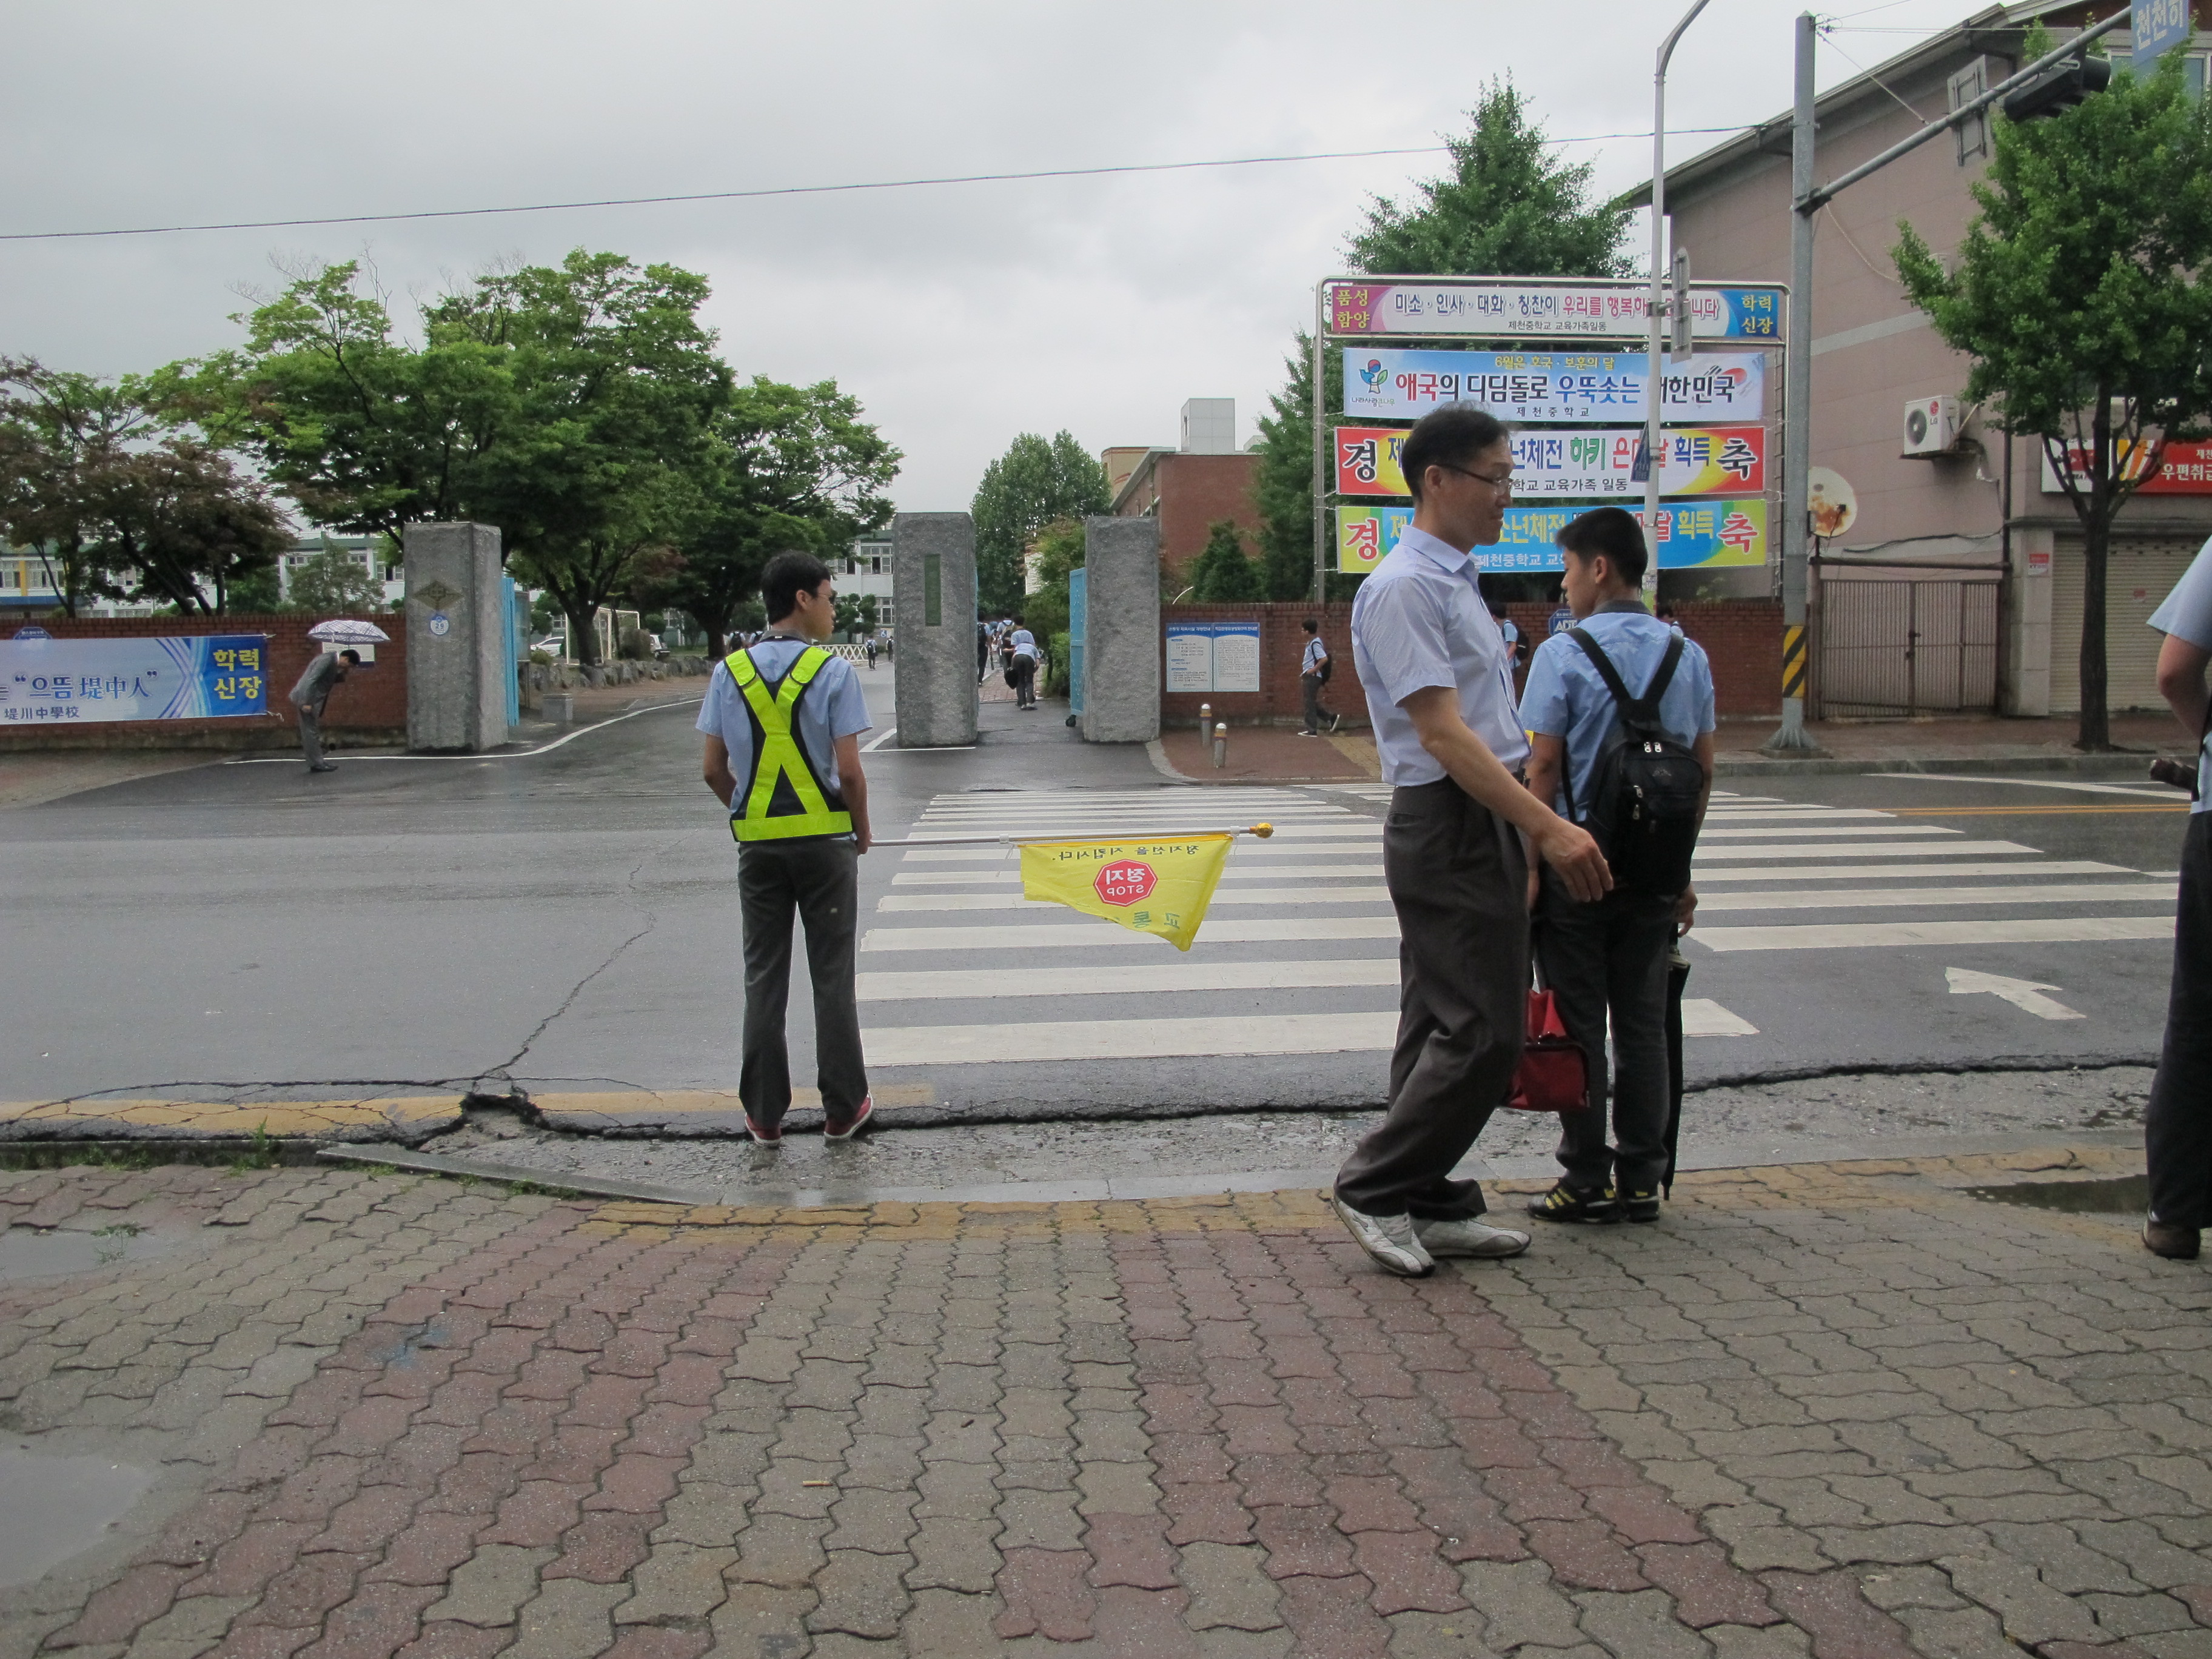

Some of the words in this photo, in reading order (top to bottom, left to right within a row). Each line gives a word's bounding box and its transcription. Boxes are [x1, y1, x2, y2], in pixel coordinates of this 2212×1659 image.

[1336, 289, 1368, 306] 품성
[1518, 294, 1558, 315] 칭찬이
[1563, 295, 1601, 316] 우리를
[1607, 296, 1649, 317] 행복하
[1741, 295, 1772, 312] 학력
[1336, 311, 1369, 328] 함양
[1508, 320, 1551, 330] 제천중학교
[1555, 321, 1607, 332] 교육가족일동
[1741, 316, 1773, 334] 신장
[1495, 356, 1524, 370] 6월은
[1531, 356, 1552, 369] 호국
[1564, 357, 1598, 370] 보훈의
[1603, 356, 1615, 370] 달
[1396, 374, 1459, 401] 애국의
[1467, 375, 1549, 403] 디딤돌로
[1555, 376, 1641, 403] 우뚝솟는
[1516, 406, 1589, 417] 제천중학교
[1342, 440, 1376, 482] 경
[1570, 437, 1606, 470] 하키
[1674, 436, 1710, 467] 획득
[1716, 438, 1758, 481] 축
[1543, 478, 1597, 491] 교육가족
[1602, 478, 1627, 491] 일동
[1678, 511, 1713, 539] 획득
[1717, 512, 1758, 553] 축
[1344, 518, 1379, 561] 경
[213, 649, 259, 671] 학력
[214, 676, 262, 699] 신장
